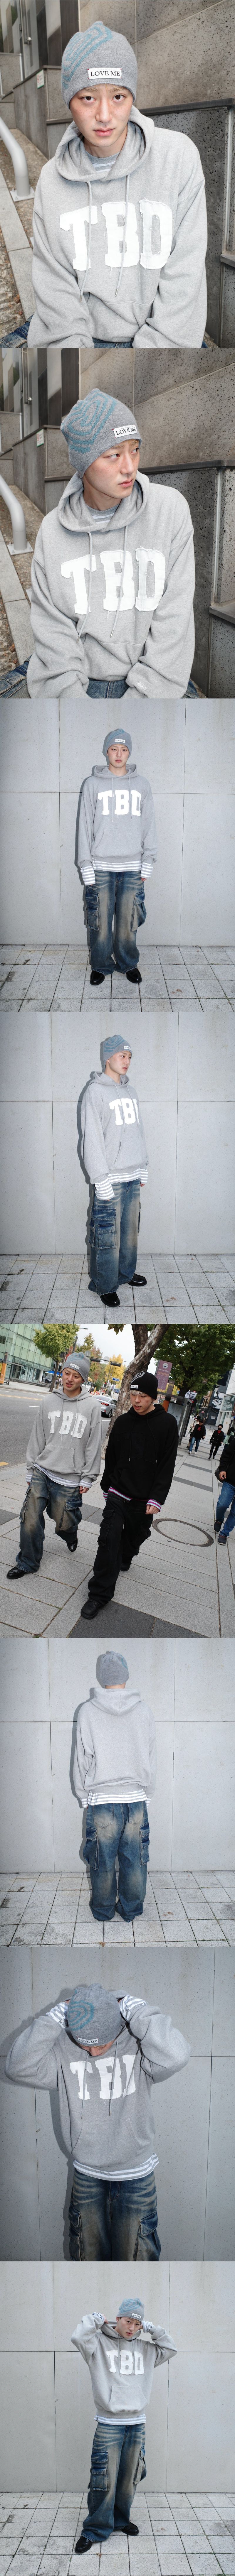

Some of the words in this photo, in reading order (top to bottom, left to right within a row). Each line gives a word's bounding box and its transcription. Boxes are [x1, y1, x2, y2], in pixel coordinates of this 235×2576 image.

[60, 198, 173, 271] TBD
[61, 547, 165, 615] TBD
[98, 789, 142, 816] TBD
[48, 1410, 88, 1439] TBD
[106, 2350, 145, 2375] TBD
